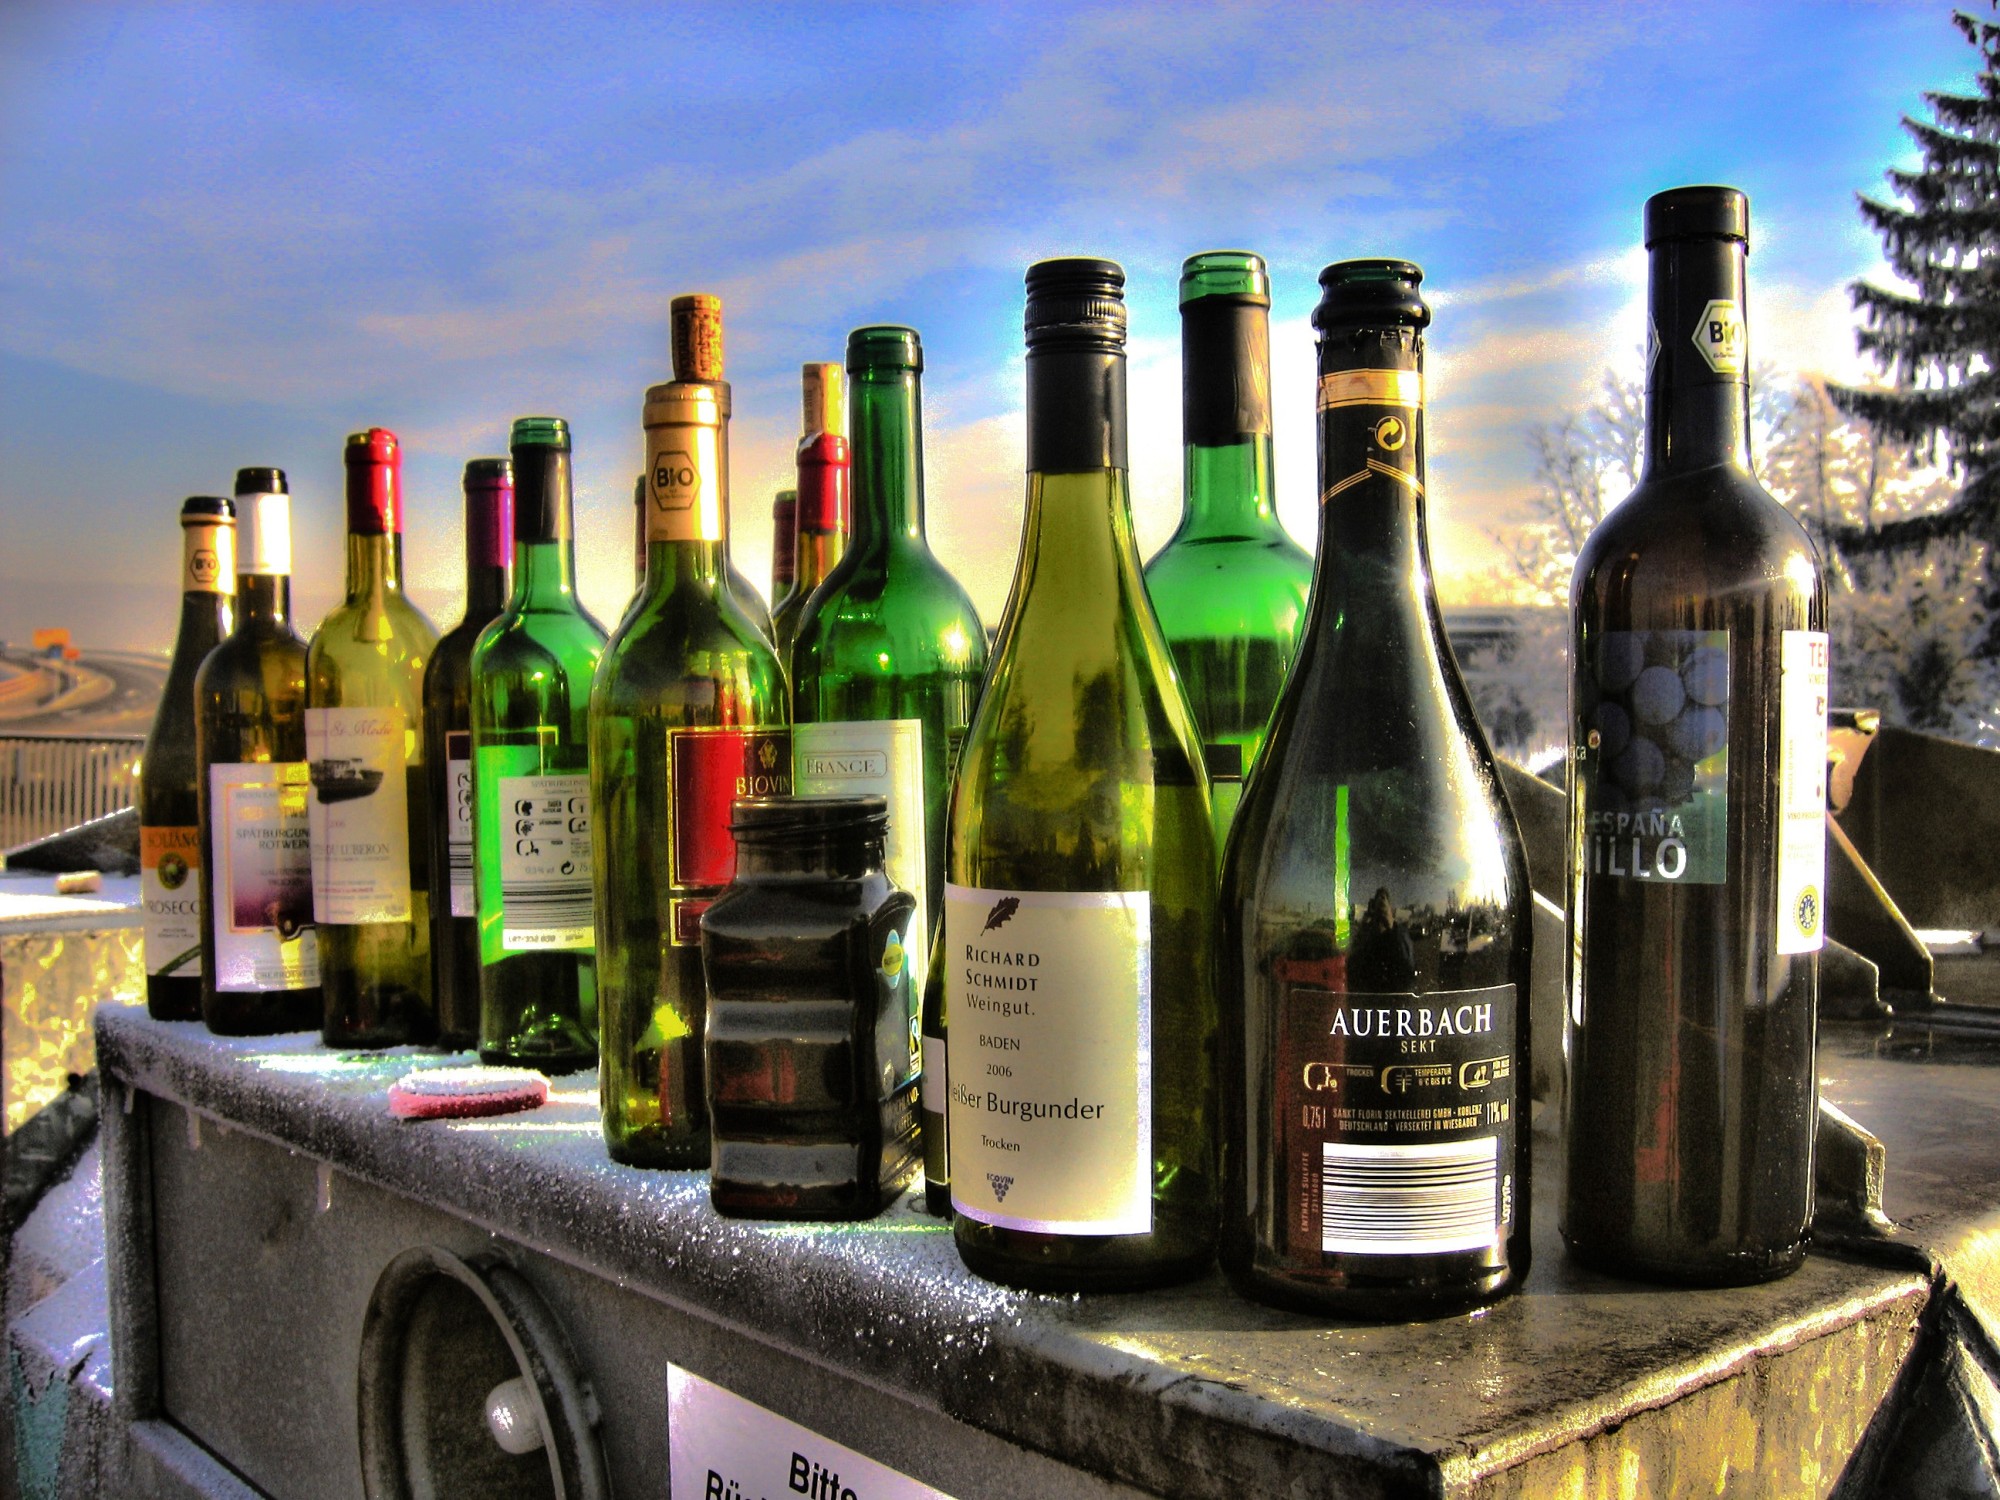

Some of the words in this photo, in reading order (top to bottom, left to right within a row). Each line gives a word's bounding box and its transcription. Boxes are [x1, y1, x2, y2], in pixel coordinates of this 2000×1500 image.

[807, 759, 875, 774] FRANCE
[736, 775, 791, 795] BIOVIN
[1592, 808, 1685, 837] ESPAÑA
[966, 945, 1040, 967] RICHARD
[966, 969, 1038, 992] SCHMIDT
[966, 993, 1036, 1018] Weingut.
[1330, 1003, 1492, 1037] AUERBACH
[979, 1034, 1020, 1051] BADEN
[1401, 1039, 1436, 1054] SEKT
[986, 1063, 1012, 1078] 2006
[1346, 1067, 1374, 1077] TROCKEN
[1414, 1067, 1452, 1077] TEMPERATUR
[987, 1092, 1105, 1122] Burgunder
[1333, 1108, 1356, 1119] SANKT
[1358, 1109, 1382, 1120] FLORIN
[1384, 1109, 1431, 1120] SEKTKELLEREI
[1457, 1104, 1483, 1116] KOBLENZ
[1340, 1120, 1388, 1131] DEUTSCHLAND
[1395, 1121, 1432, 1131] VERSEKTET
[1443, 1116, 1477, 1130] WIESBADEN
[981, 1134, 1020, 1152] Trocken
[987, 1172, 1014, 1185] ECOVIN
